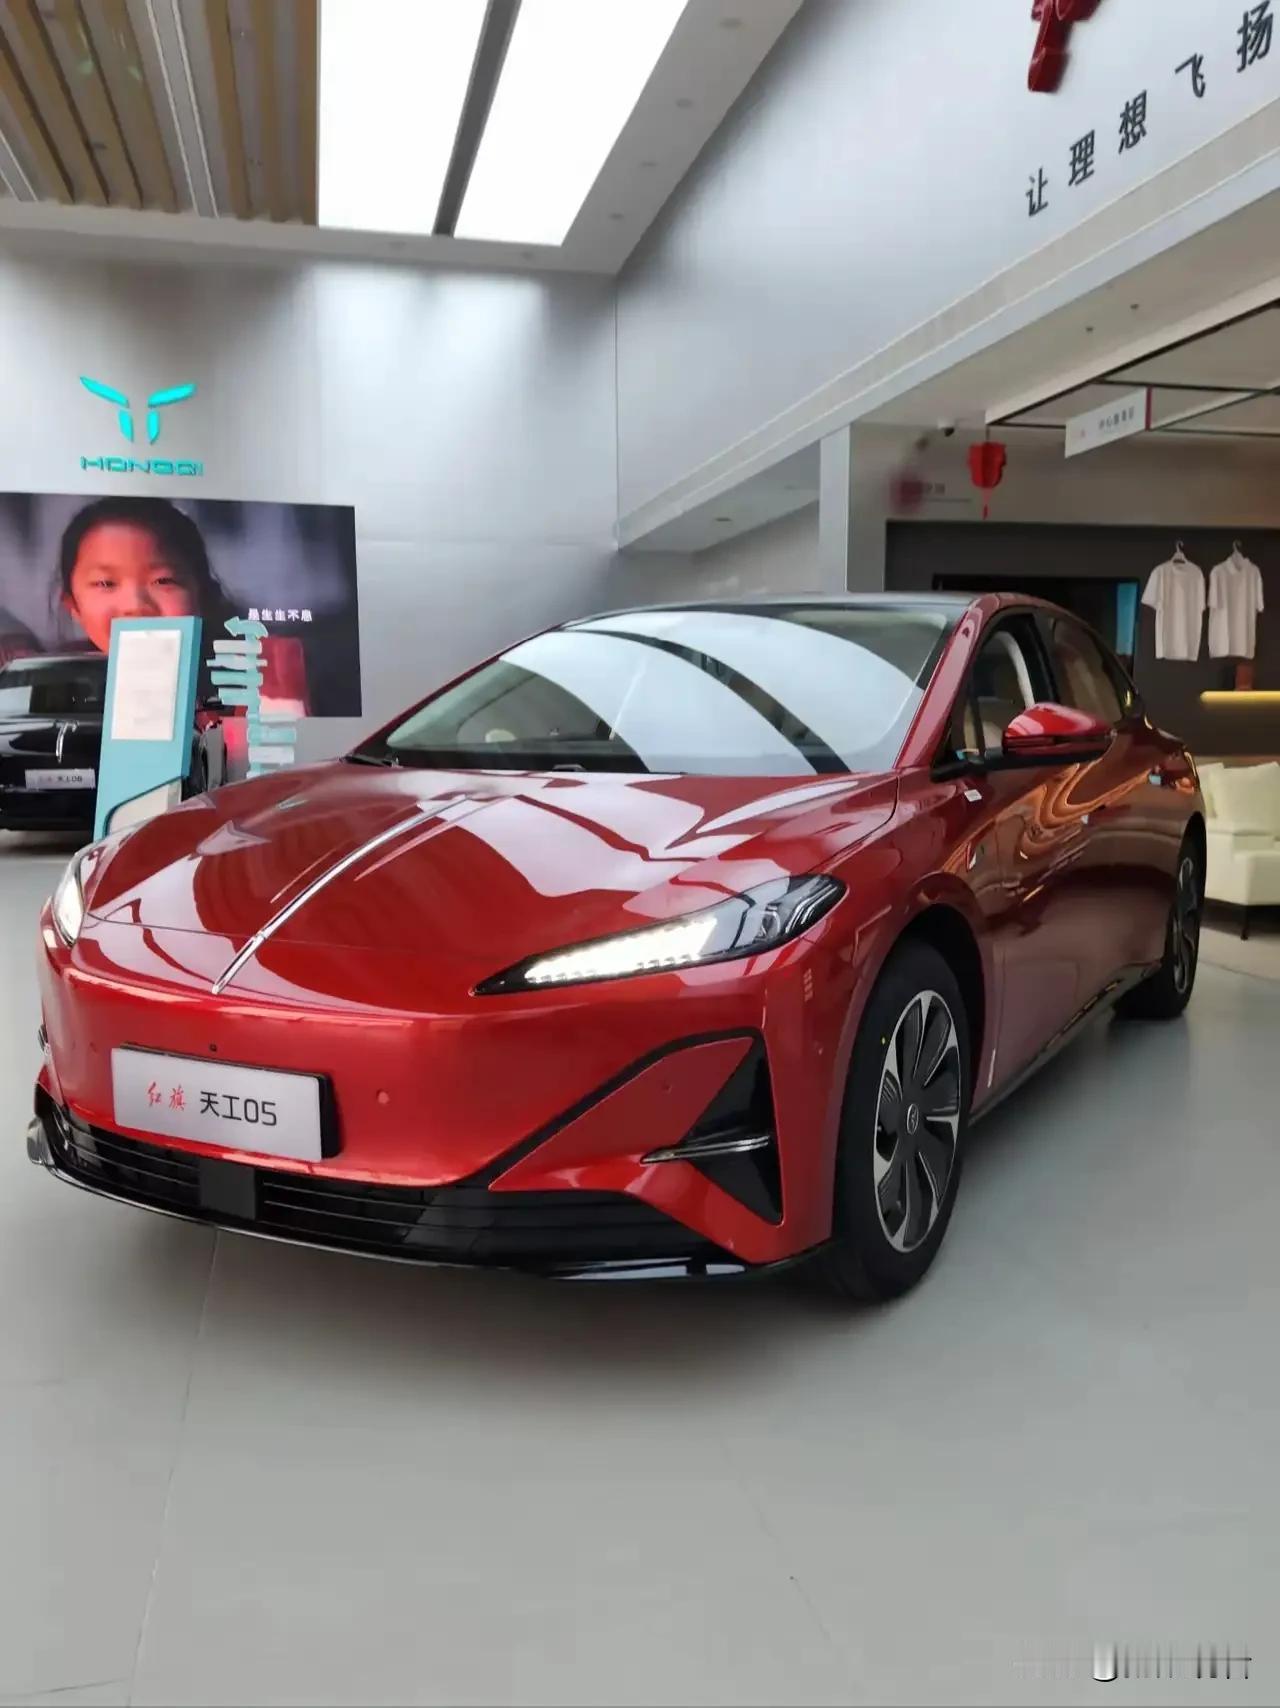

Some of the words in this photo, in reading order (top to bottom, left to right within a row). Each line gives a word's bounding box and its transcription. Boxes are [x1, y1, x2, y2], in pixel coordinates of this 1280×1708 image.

[1025, 0, 1274, 217] 让理想飞扬
[80, 456, 204, 476] HONGQI
[146, 1081, 186, 1111] 红旗
[200, 1091, 277, 1126] 天工05
